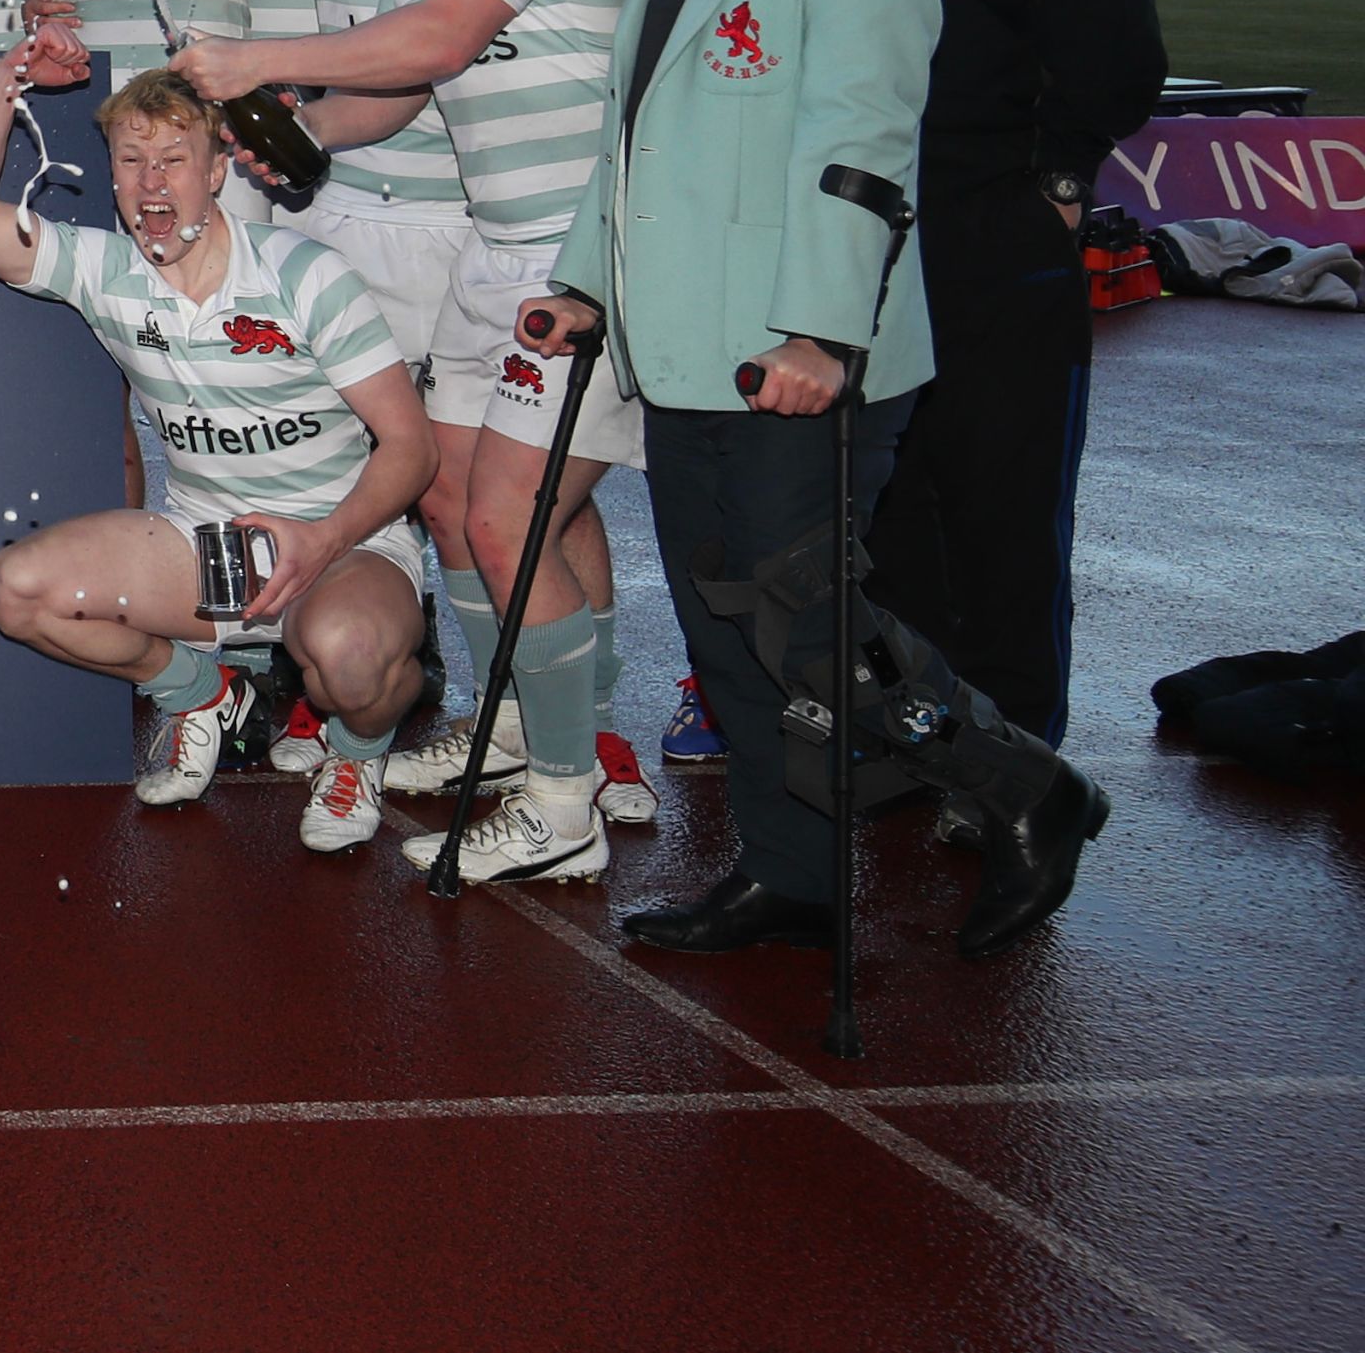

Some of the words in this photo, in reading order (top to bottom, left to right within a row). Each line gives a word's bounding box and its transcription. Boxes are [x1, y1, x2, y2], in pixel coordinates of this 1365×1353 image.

[1111, 140, 1169, 211] Y
[1210, 139, 1365, 211] IND
[156, 407, 322, 455] Jefferies
[515, 807, 540, 834] PUMA
